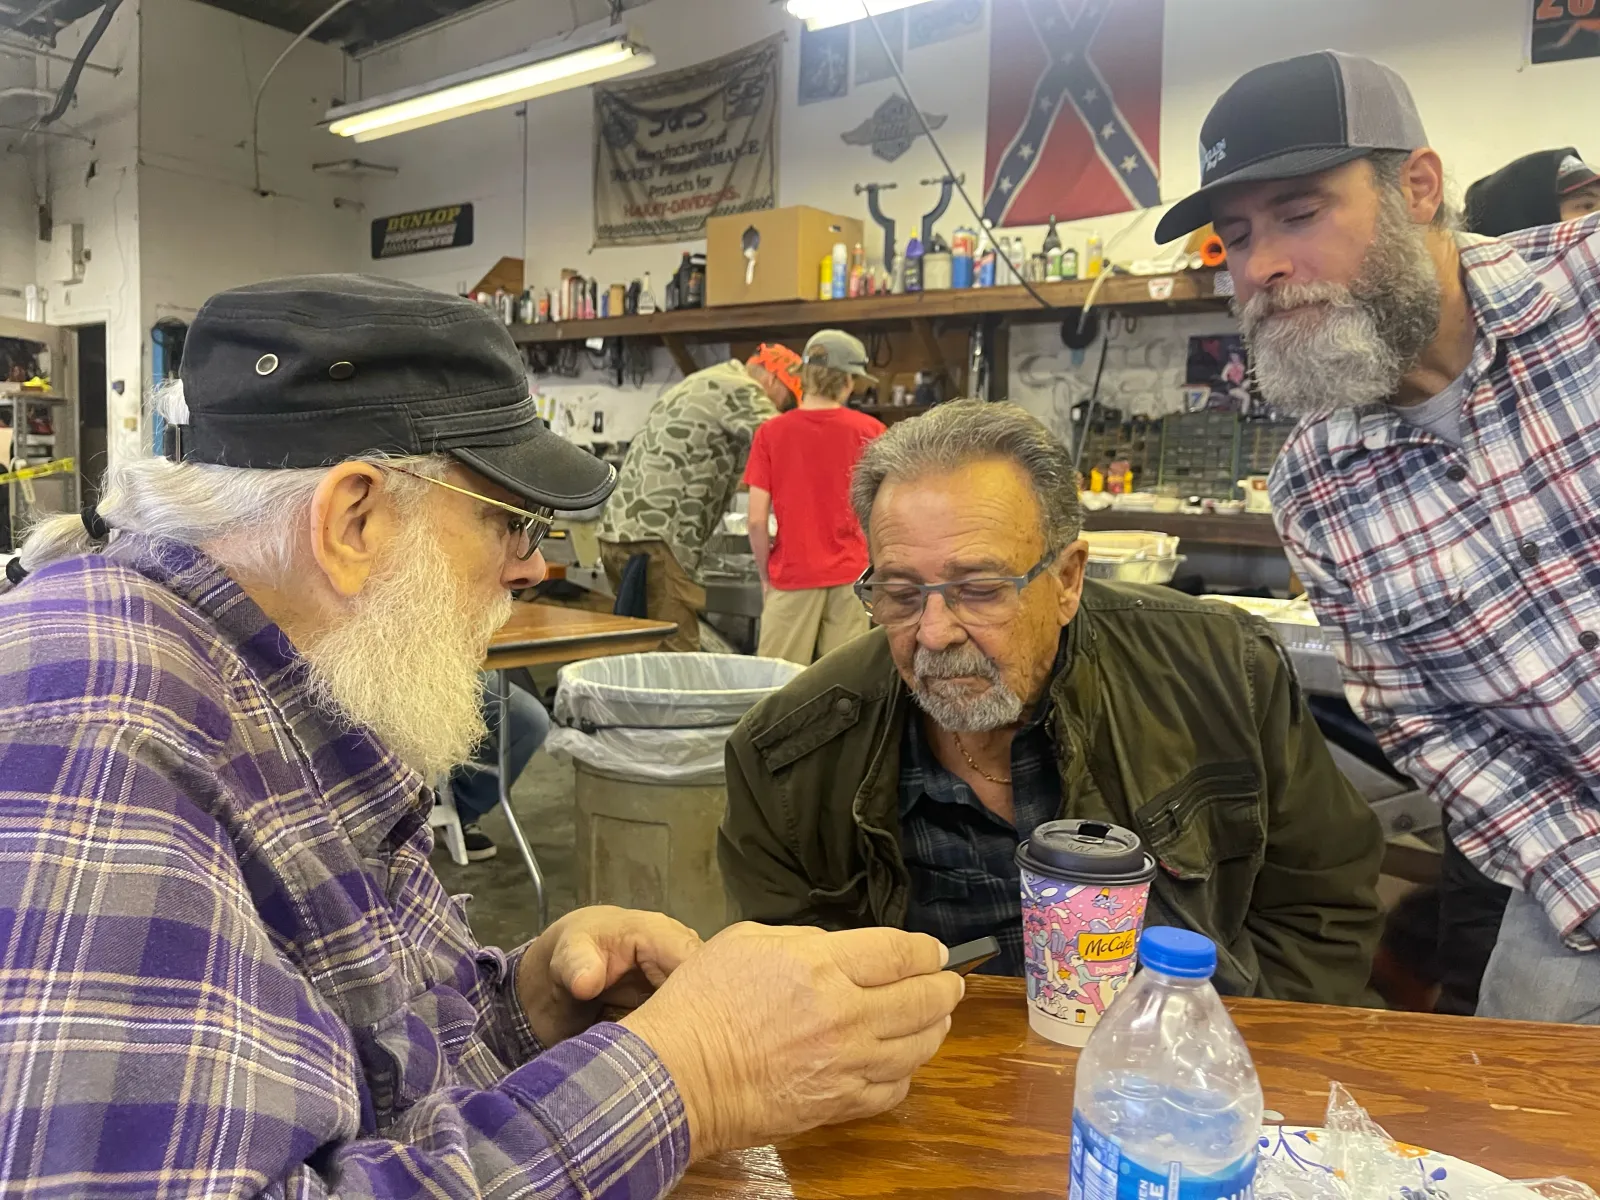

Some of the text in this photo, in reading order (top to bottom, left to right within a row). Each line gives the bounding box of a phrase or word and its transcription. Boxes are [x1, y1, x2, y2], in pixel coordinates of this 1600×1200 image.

[649, 174, 713, 199] Products for
[386, 207, 462, 231] DUNLOP
[1084, 931, 1133, 957] McCafé
